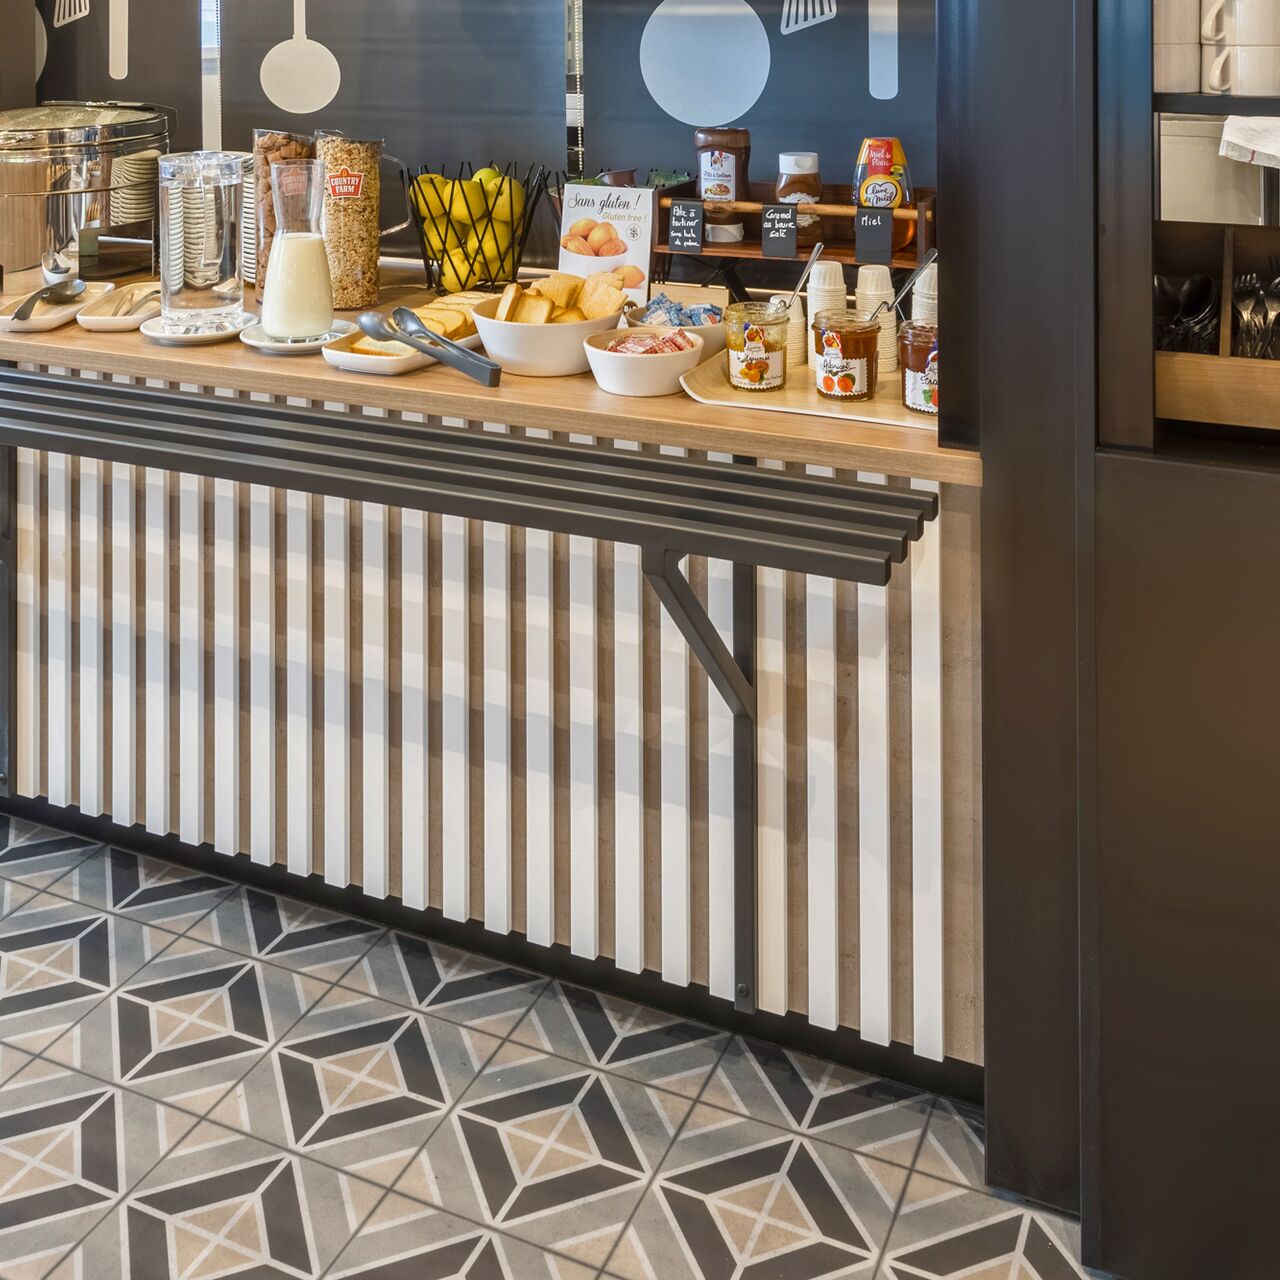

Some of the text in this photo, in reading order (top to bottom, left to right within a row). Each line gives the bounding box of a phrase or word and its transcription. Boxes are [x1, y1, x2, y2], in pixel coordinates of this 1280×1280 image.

[870, 150, 885, 159] Miel
[330, 177, 360, 186] COUNTRY
[335, 185, 355, 194] FARM
[567, 192, 596, 209] Sans
[597, 193, 632, 214] gluten
[602, 211, 626, 221] Gluten
[626, 212, 642, 222] free
[766, 209, 792, 219] Caramel
[672, 217, 699, 227] tartiner
[861, 215, 882, 226] Miel
[920, 372, 938, 385] Fra
